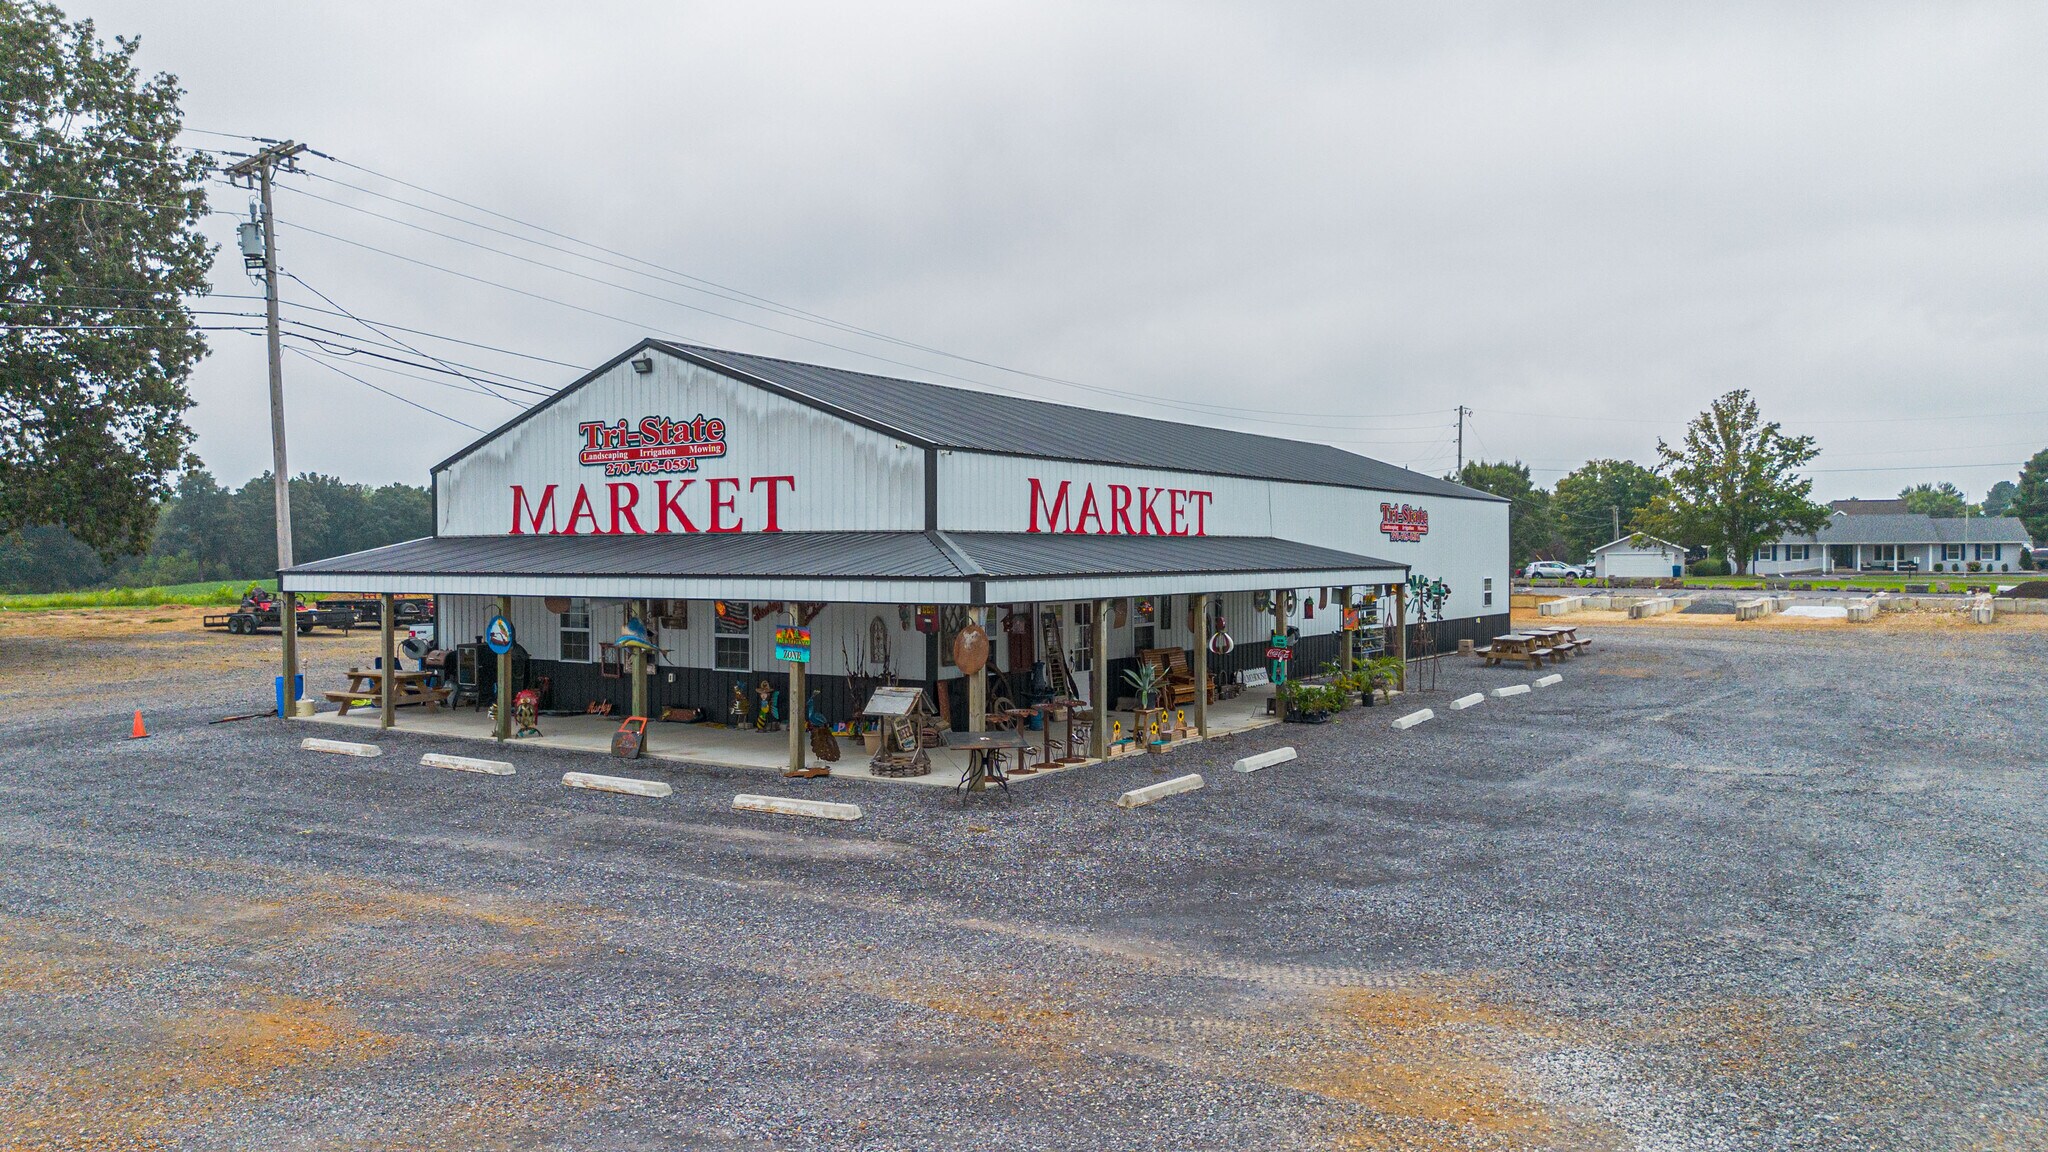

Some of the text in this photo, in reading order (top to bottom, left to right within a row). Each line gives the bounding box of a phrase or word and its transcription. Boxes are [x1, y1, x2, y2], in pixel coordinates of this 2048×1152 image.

[580, 416, 725, 450] Tri-State
[583, 445, 721, 461] Landscaping Irrigation Mowing
[606, 458, 697, 475] 270-705-0591
[509, 475, 795, 535] MARKET
[1027, 477, 1213, 537] MARKET
[1381, 503, 1428, 524] Tri-State
[783, 650, 801, 660] ZONE
